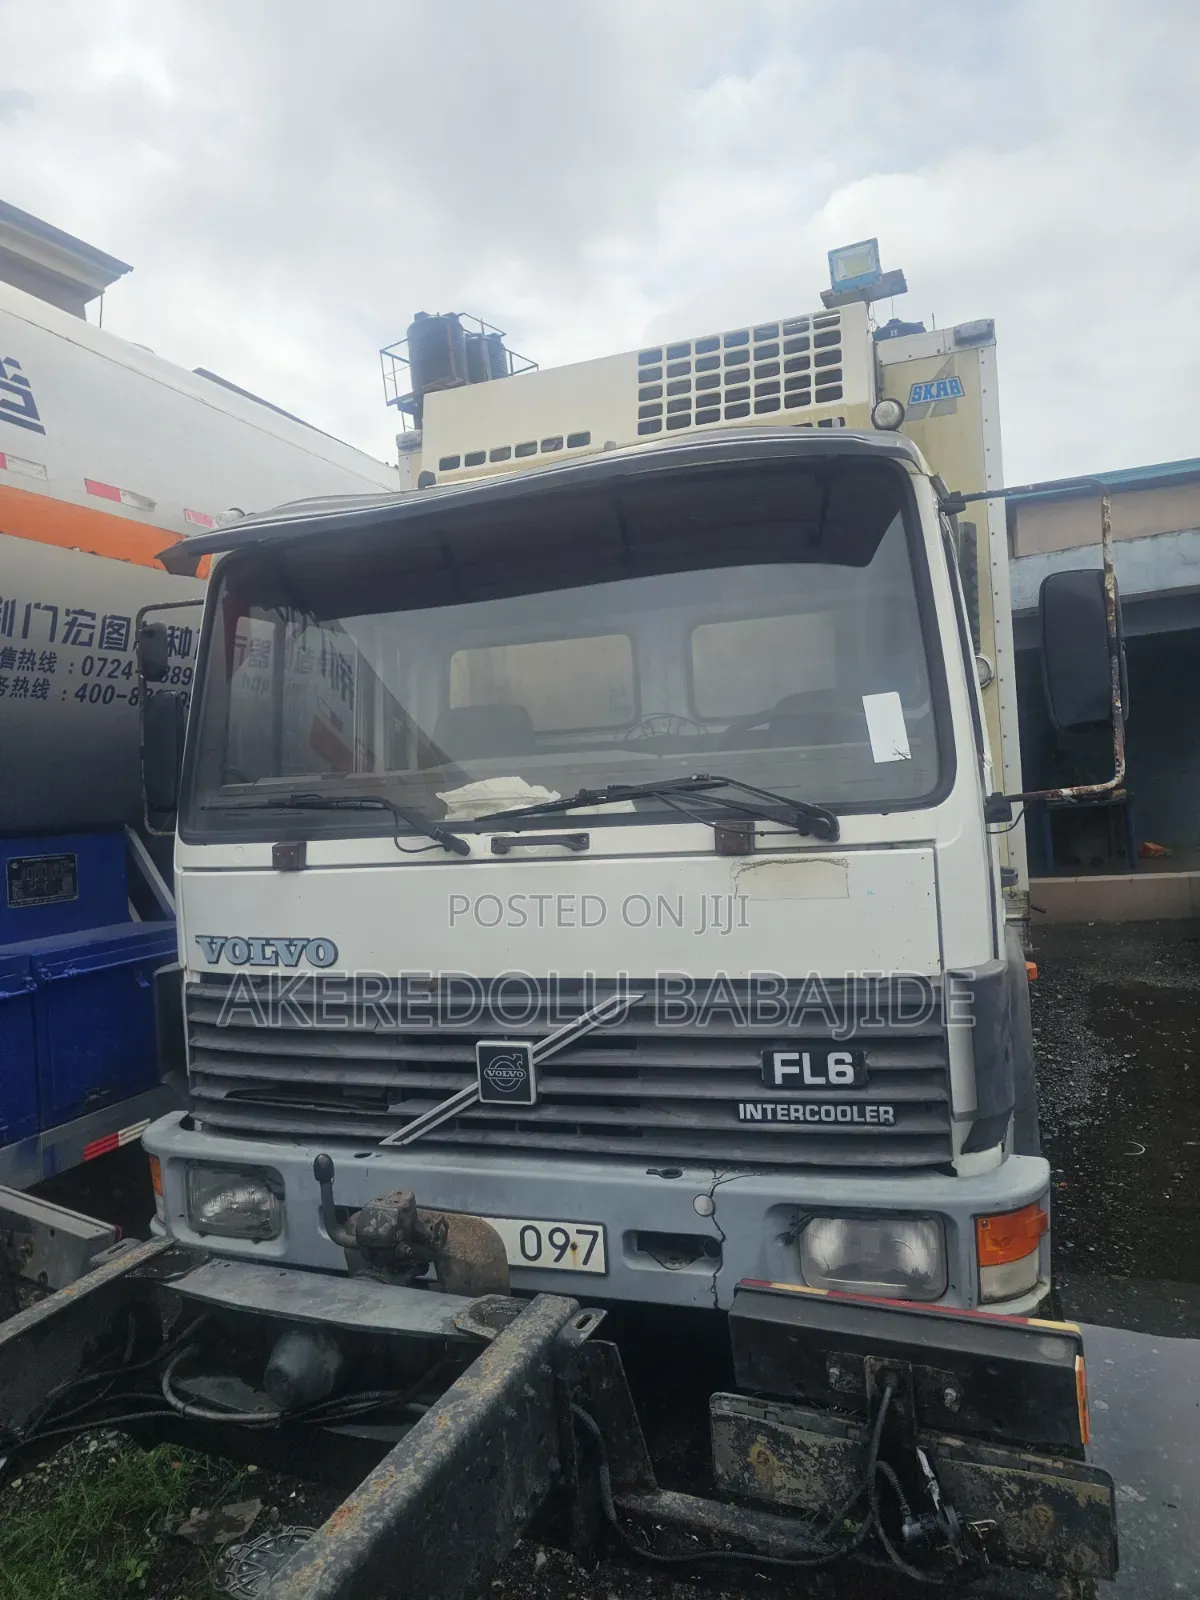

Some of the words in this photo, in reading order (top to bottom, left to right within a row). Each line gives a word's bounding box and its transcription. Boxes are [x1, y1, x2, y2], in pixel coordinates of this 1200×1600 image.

[911, 378, 962, 403] SKAB
[195, 934, 339, 968] VOLVO
[487, 1069, 524, 1078] VOLVO
[773, 1051, 855, 1085] FL6
[738, 1102, 896, 1124] INTERCOOLER
[519, 1224, 600, 1266] 097
